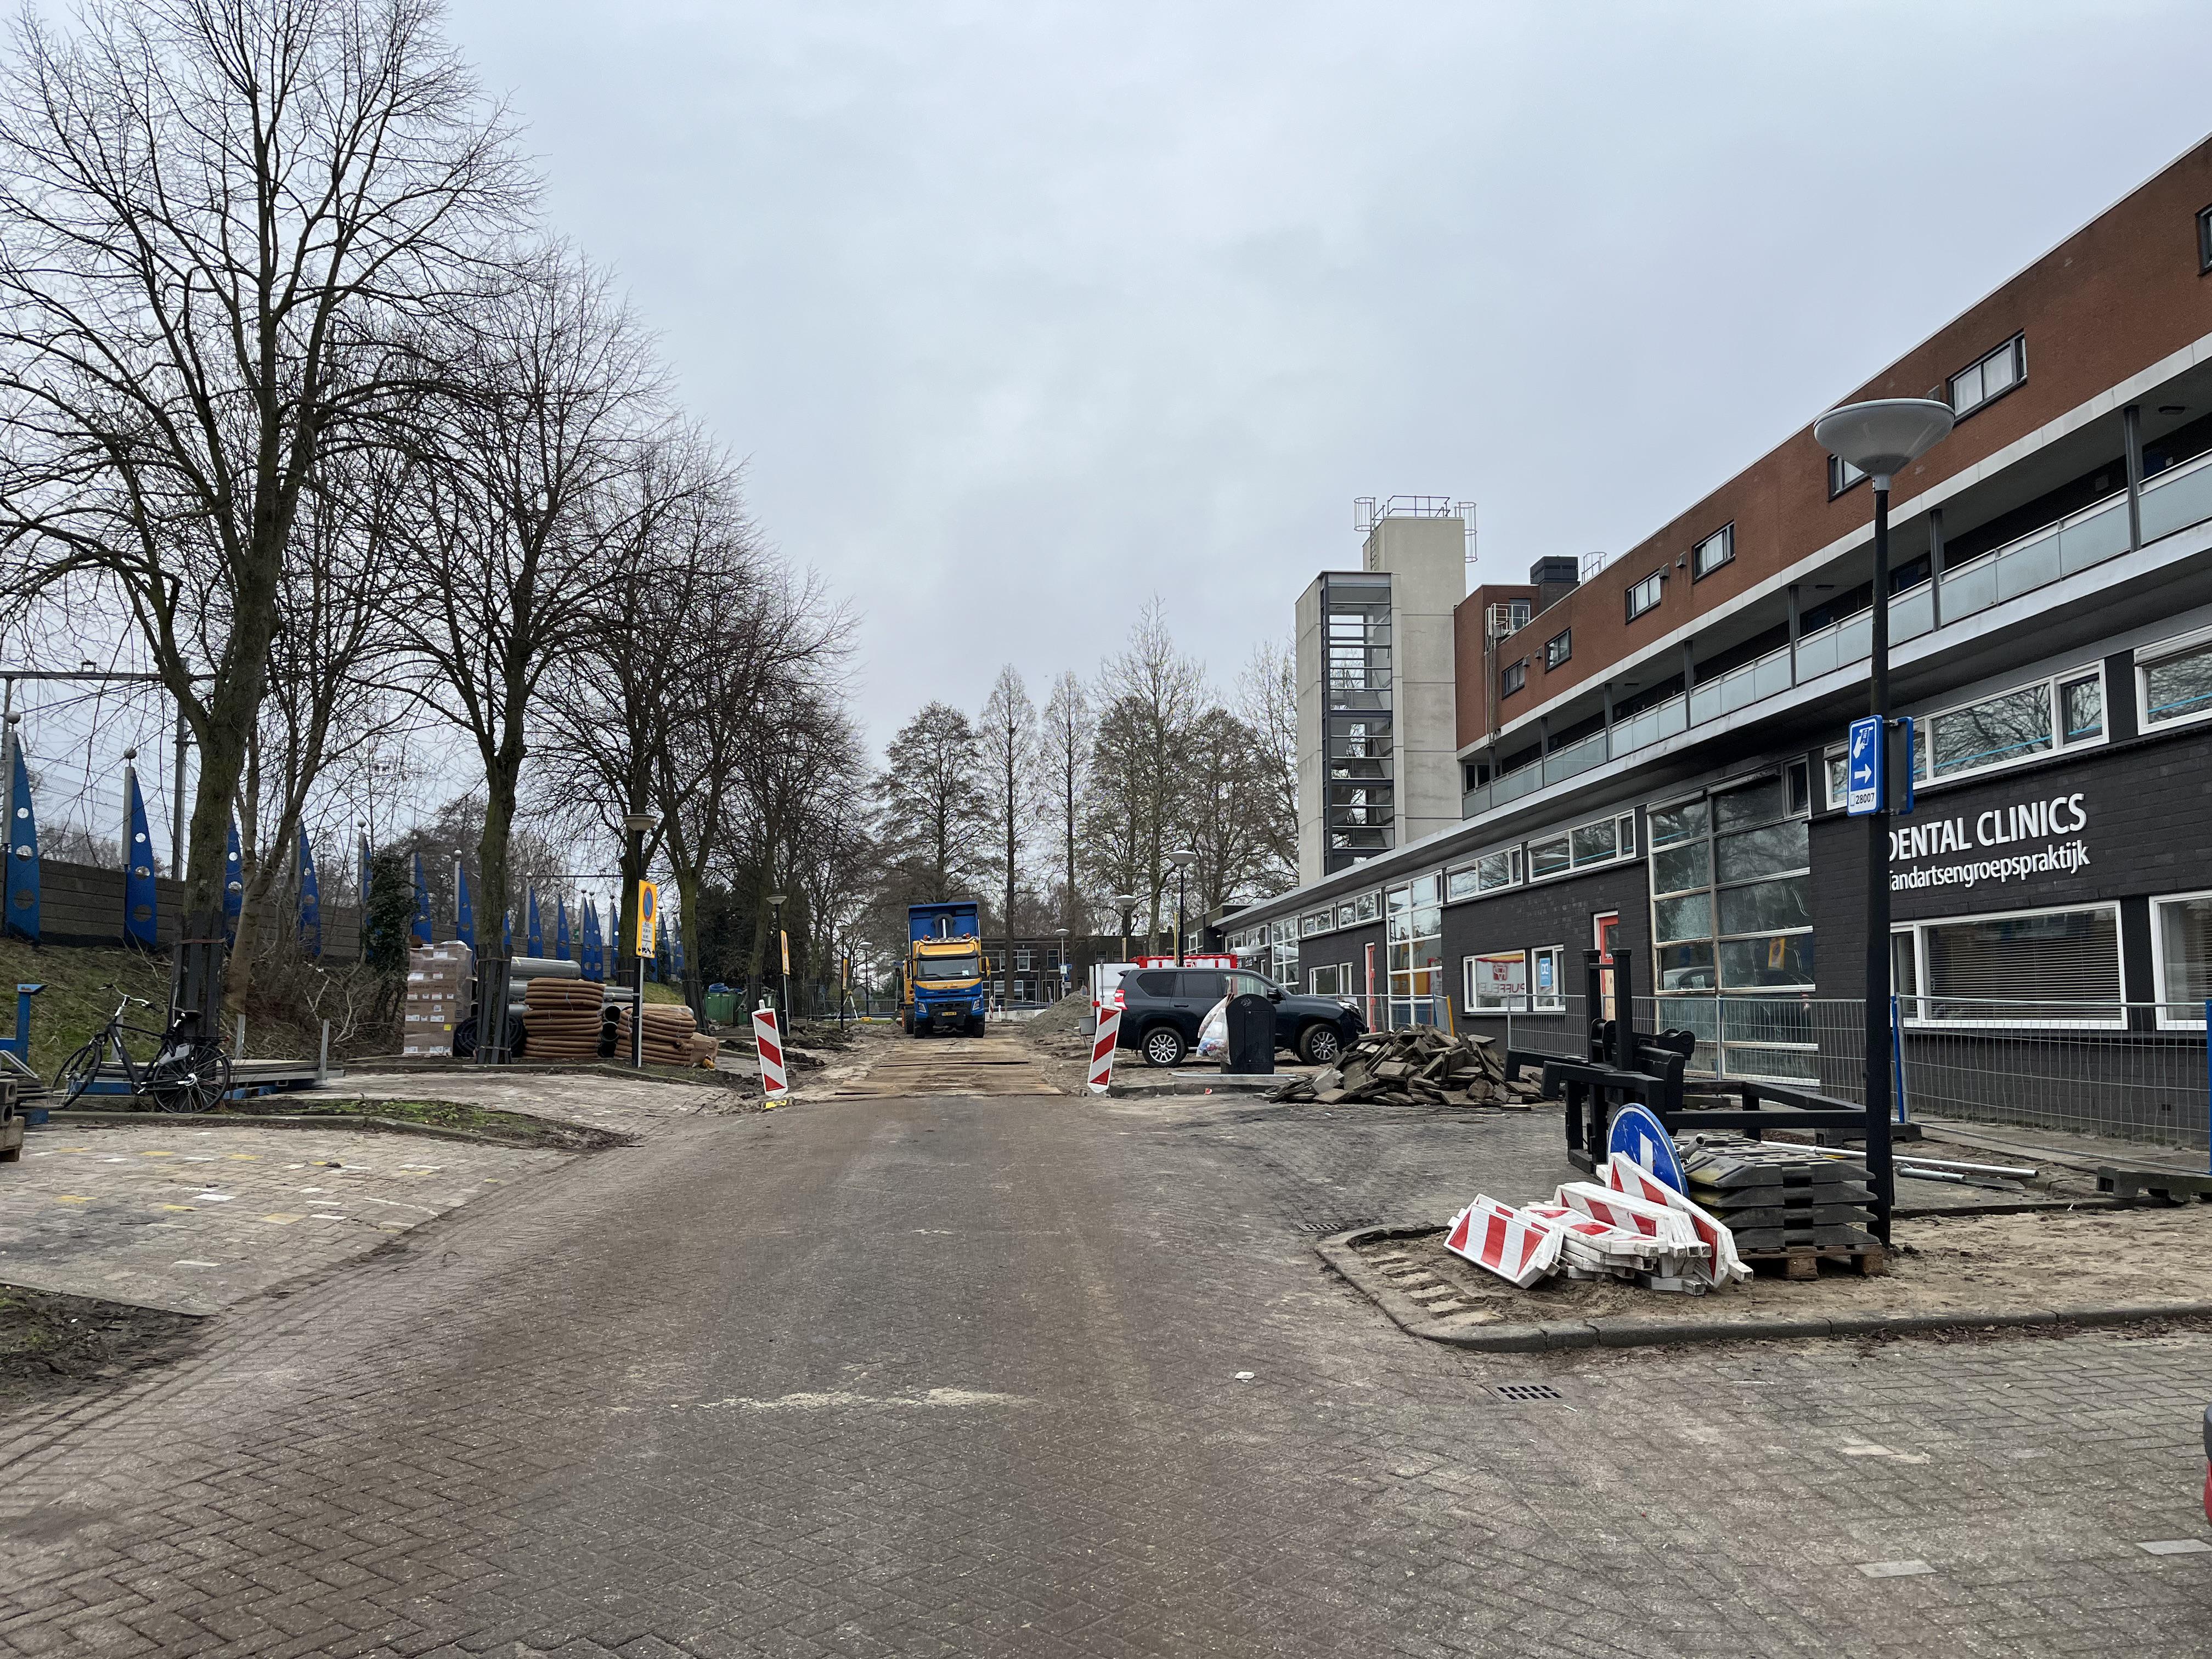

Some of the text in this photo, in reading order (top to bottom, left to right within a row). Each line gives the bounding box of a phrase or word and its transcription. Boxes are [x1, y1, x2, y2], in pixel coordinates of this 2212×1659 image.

[1855, 792, 1875, 804] 28007
[1889, 793, 2087, 861] DENTAL CLINICS
